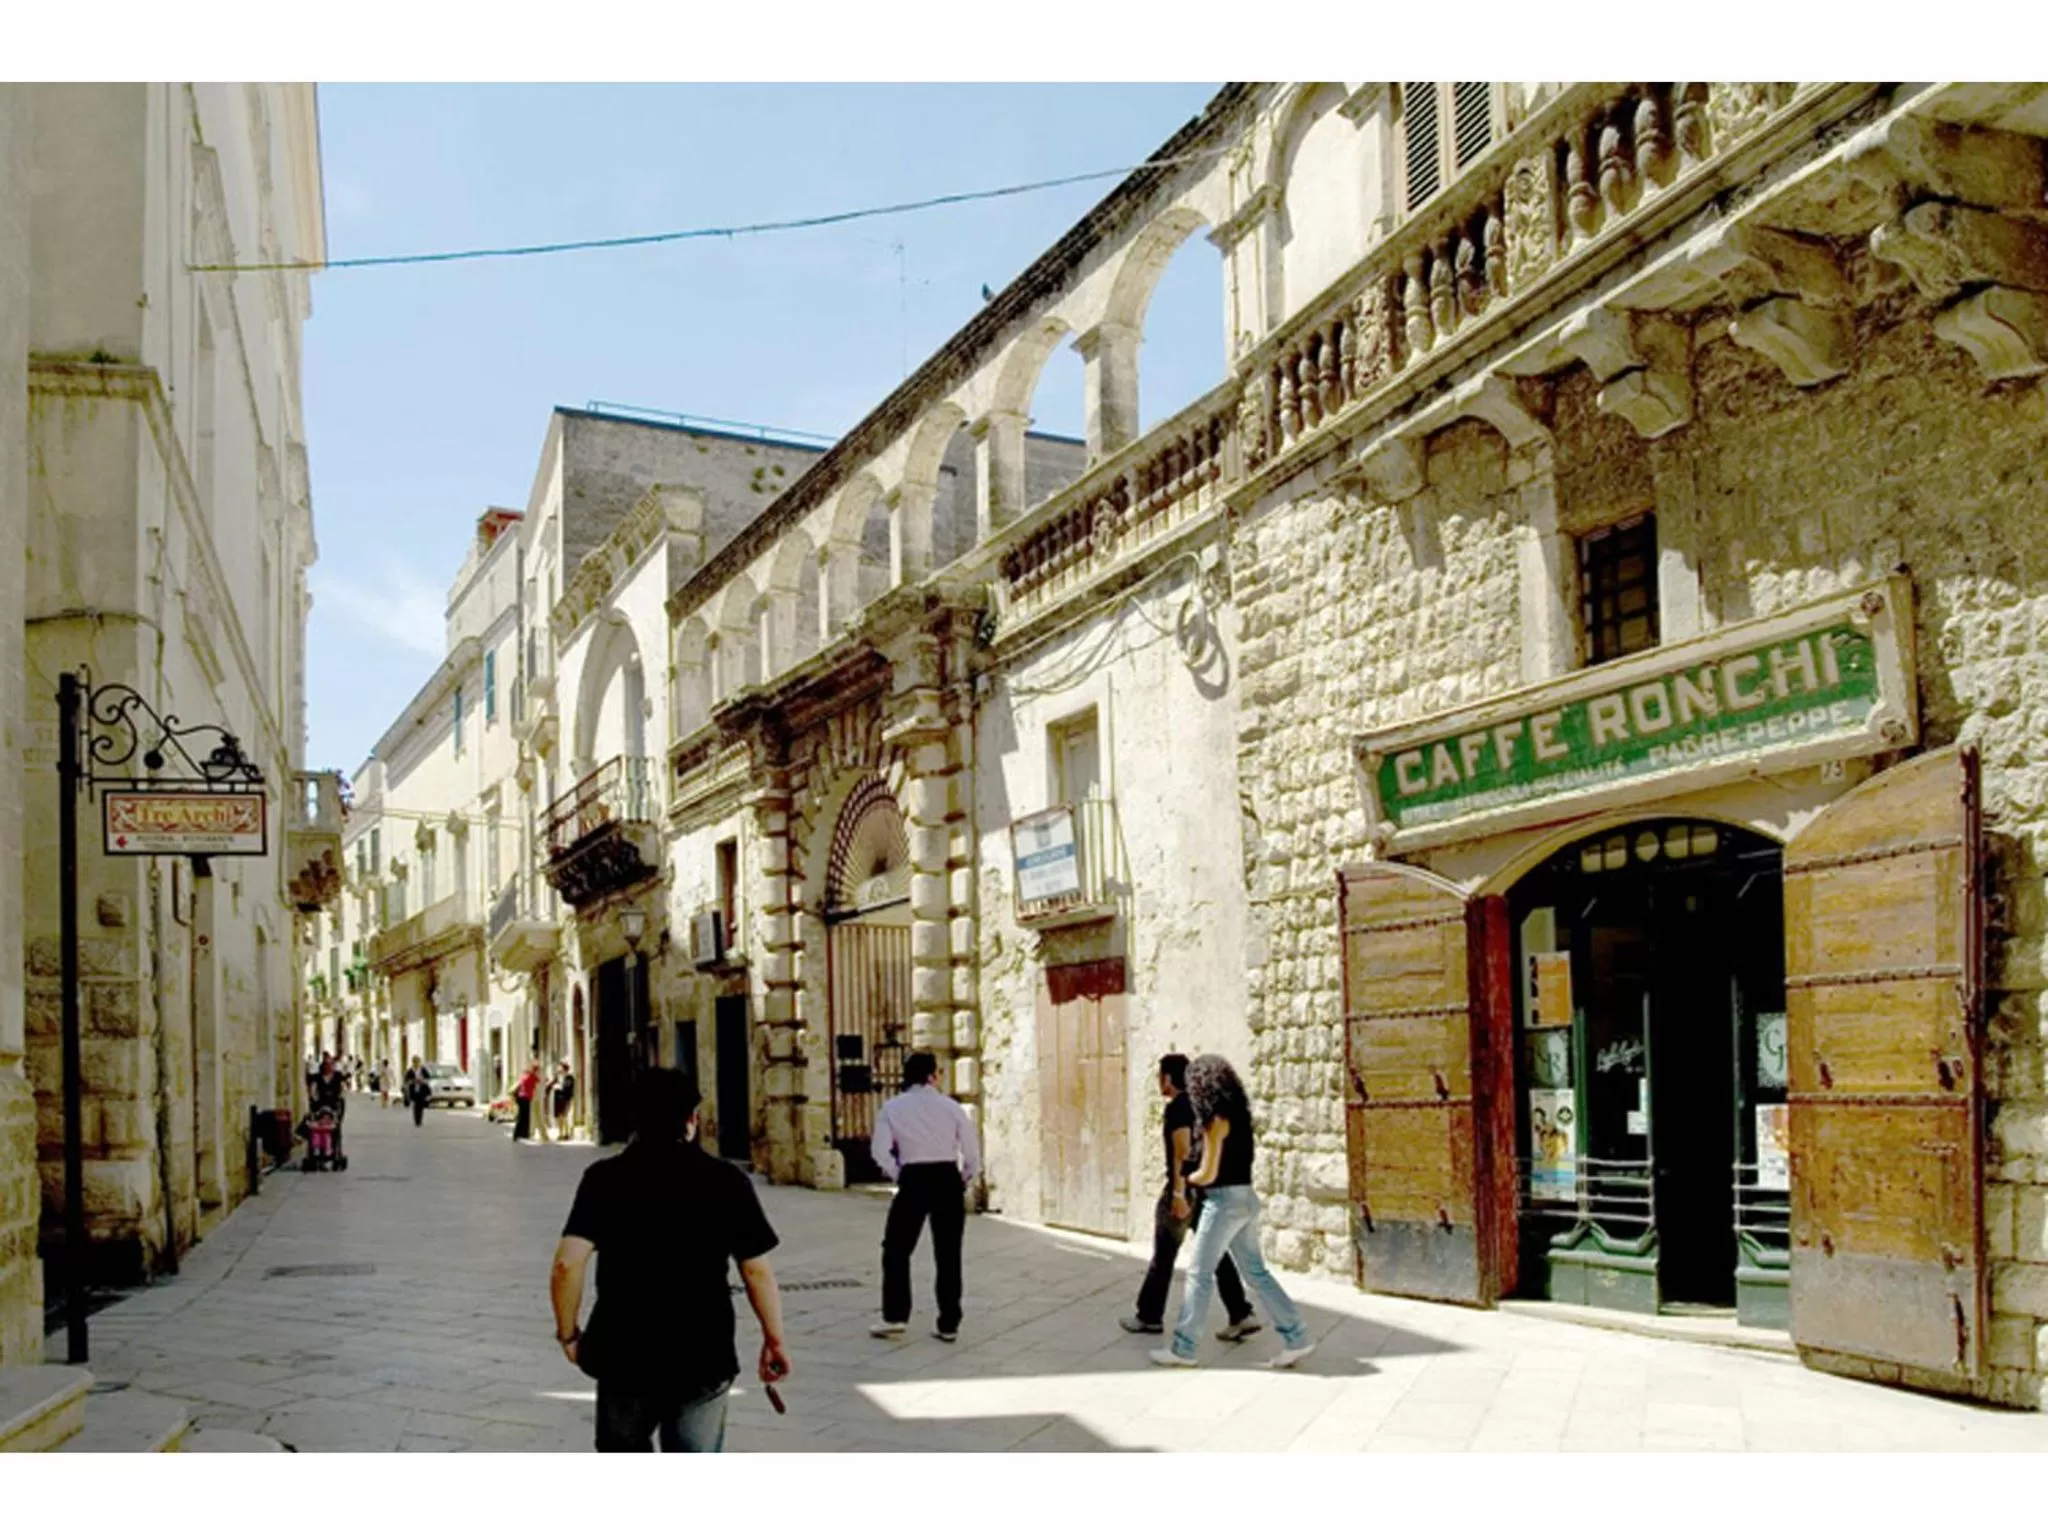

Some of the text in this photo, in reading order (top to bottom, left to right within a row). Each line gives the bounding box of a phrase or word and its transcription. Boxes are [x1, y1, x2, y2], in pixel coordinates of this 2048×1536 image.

[1586, 632, 1841, 745] RONCHI
[1647, 728, 1740, 767] PADRE
[1746, 701, 1851, 744] PEPPE
